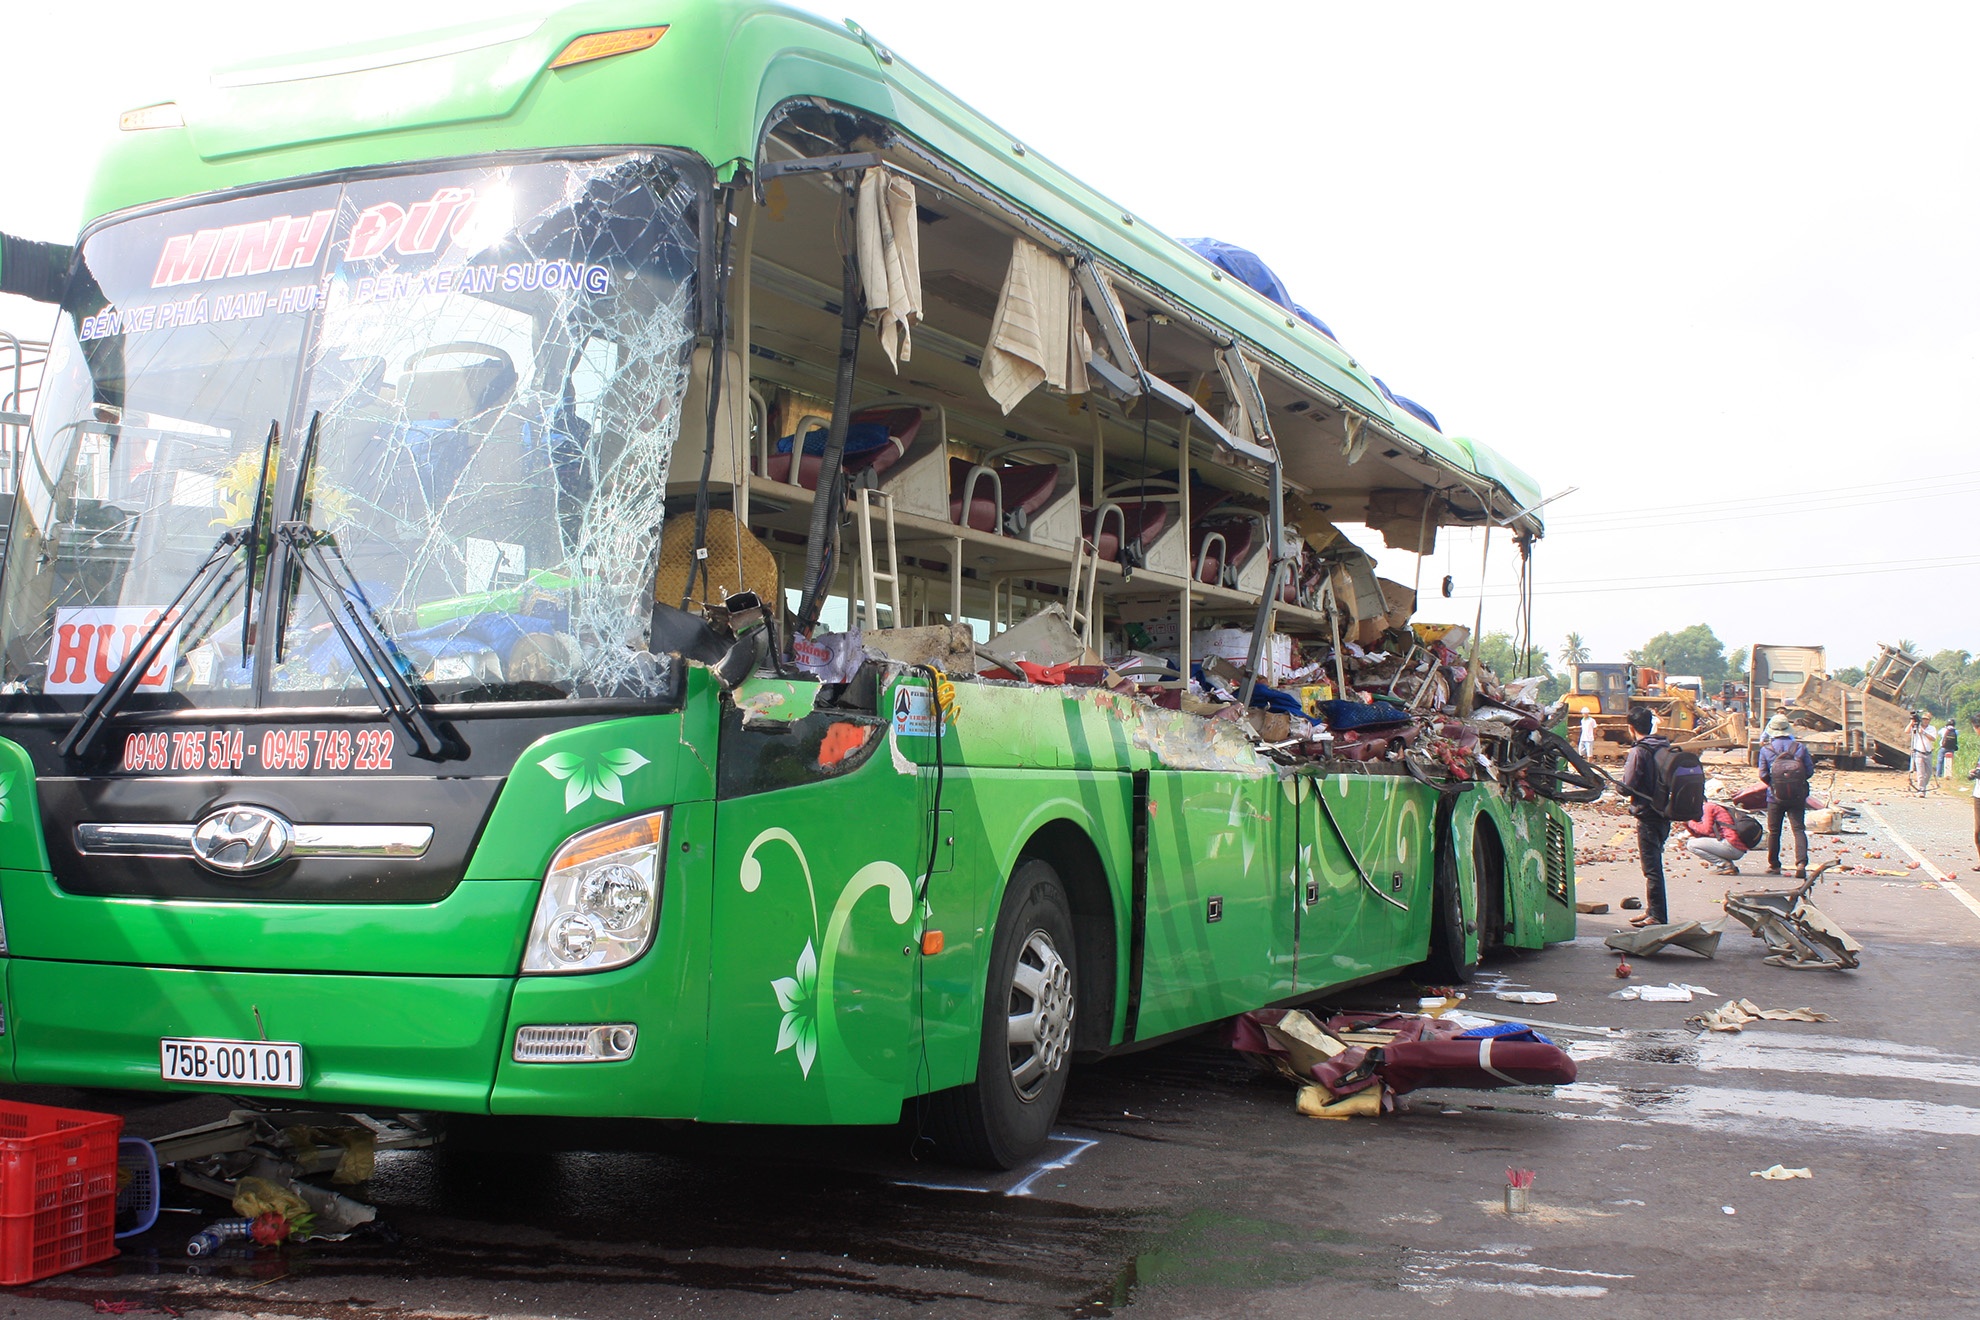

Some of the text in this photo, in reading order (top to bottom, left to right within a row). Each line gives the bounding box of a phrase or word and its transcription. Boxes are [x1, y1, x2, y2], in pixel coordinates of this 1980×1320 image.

[151, 209, 336, 288] MINH
[79, 304, 123, 342] BẾN
[124, 304, 157, 334] XE
[157, 294, 210, 330] PHÍA
[355, 264, 408, 301] BẾN
[420, 269, 452, 296] XE
[458, 264, 498, 293] AN
[501, 259, 610, 295] SƯƠNG
[124, 732, 168, 770] 0948
[171, 731, 206, 769] 765
[208, 730, 243, 769] 514
[262, 730, 310, 769] 0945
[313, 730, 350, 769] 743
[354, 730, 394, 770] 232
[165, 1043, 293, 1082] 75B-001.01
